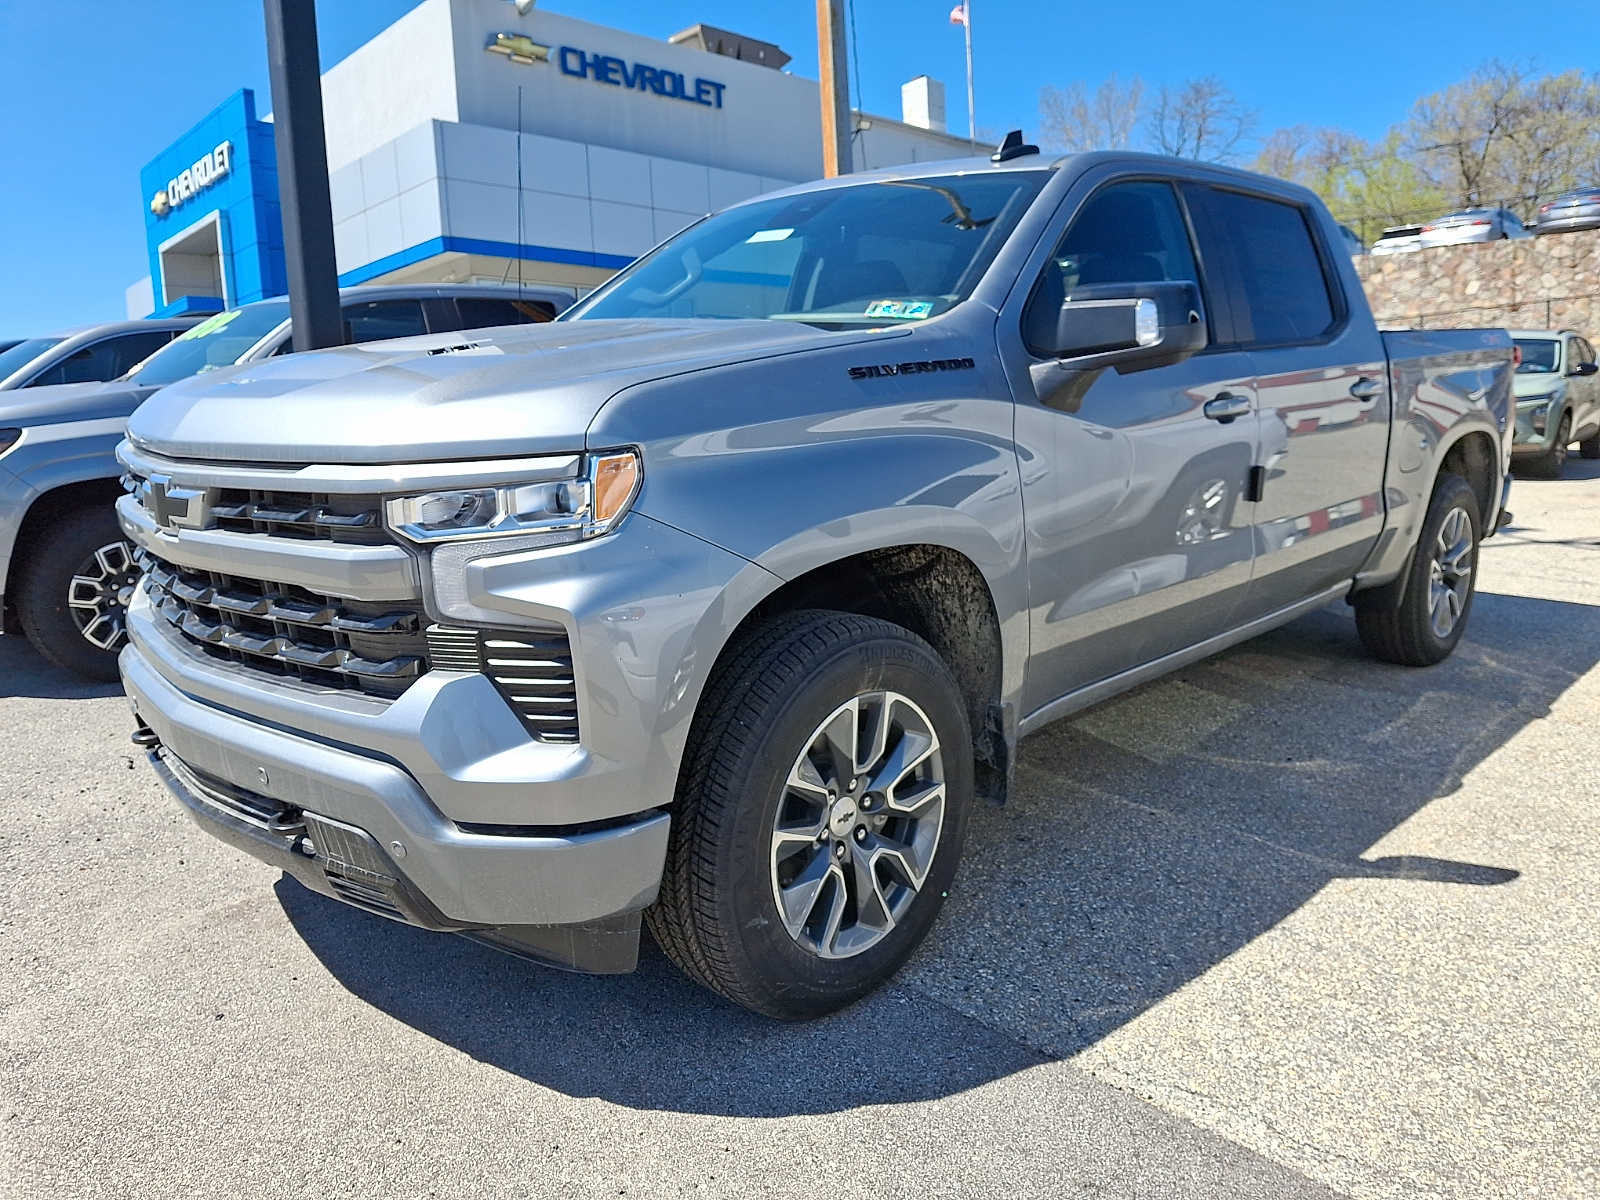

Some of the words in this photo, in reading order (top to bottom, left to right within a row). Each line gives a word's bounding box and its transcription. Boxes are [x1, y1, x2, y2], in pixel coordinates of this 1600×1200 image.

[560, 46, 726, 109] CHEVROLET
[168, 140, 230, 206] CHEVROLET
[849, 358, 975, 379] SILVERADO
